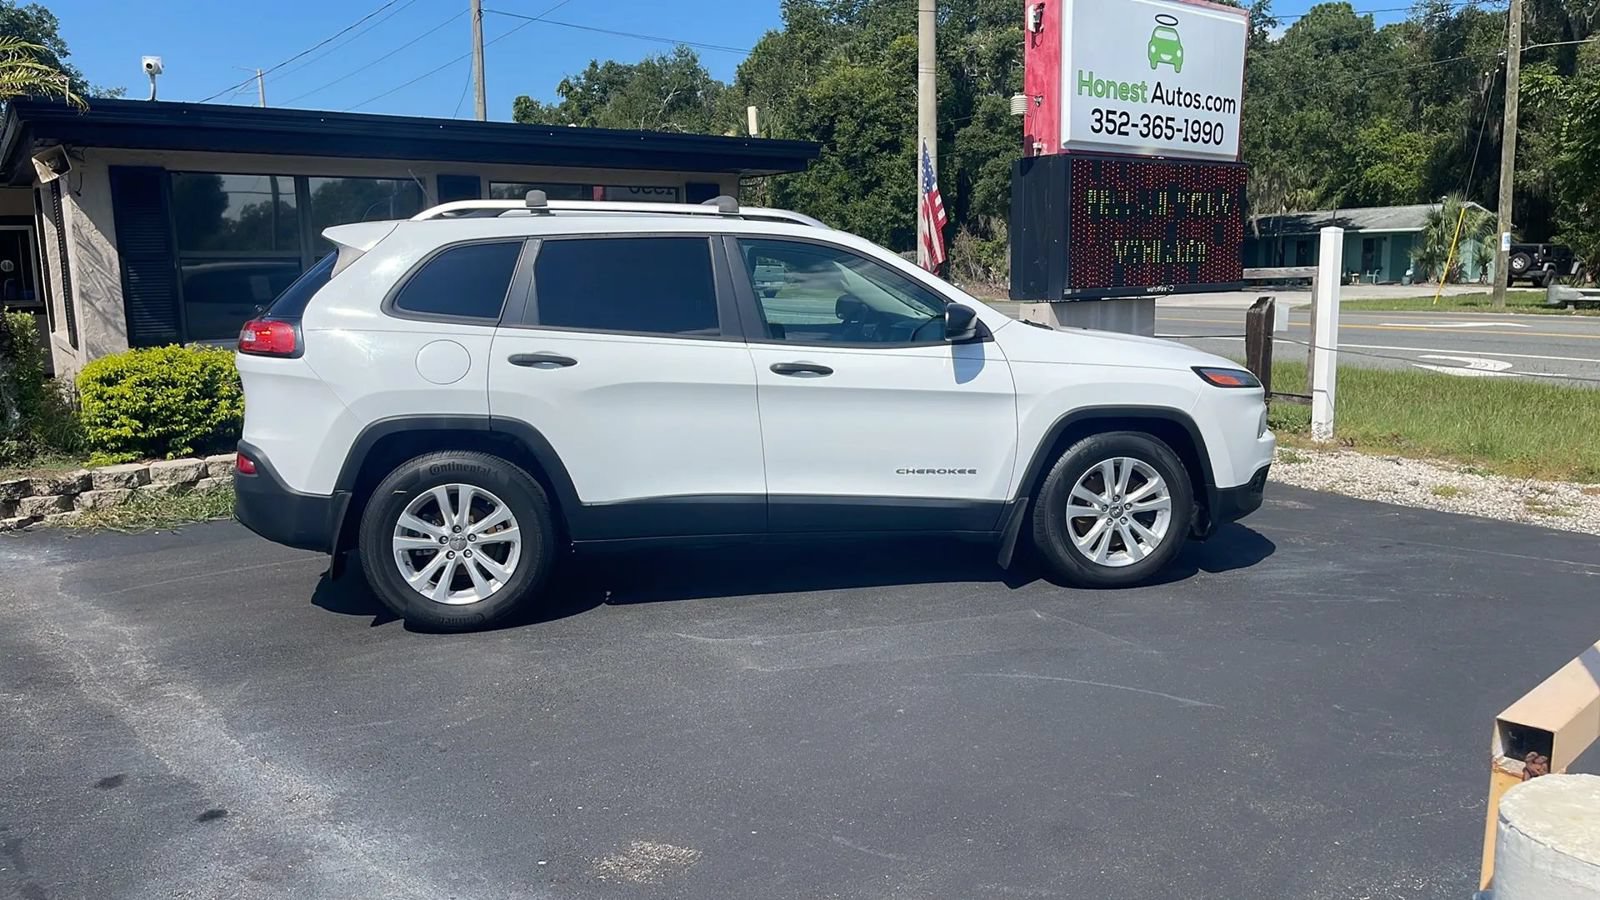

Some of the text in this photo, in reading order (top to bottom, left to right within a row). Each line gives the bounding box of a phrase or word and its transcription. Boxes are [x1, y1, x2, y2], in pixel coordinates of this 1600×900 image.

[1077, 70, 1237, 115] Honest Autos.com
[1090, 108, 1225, 146] 352-365-1990
[429, 461, 492, 476] Continental
